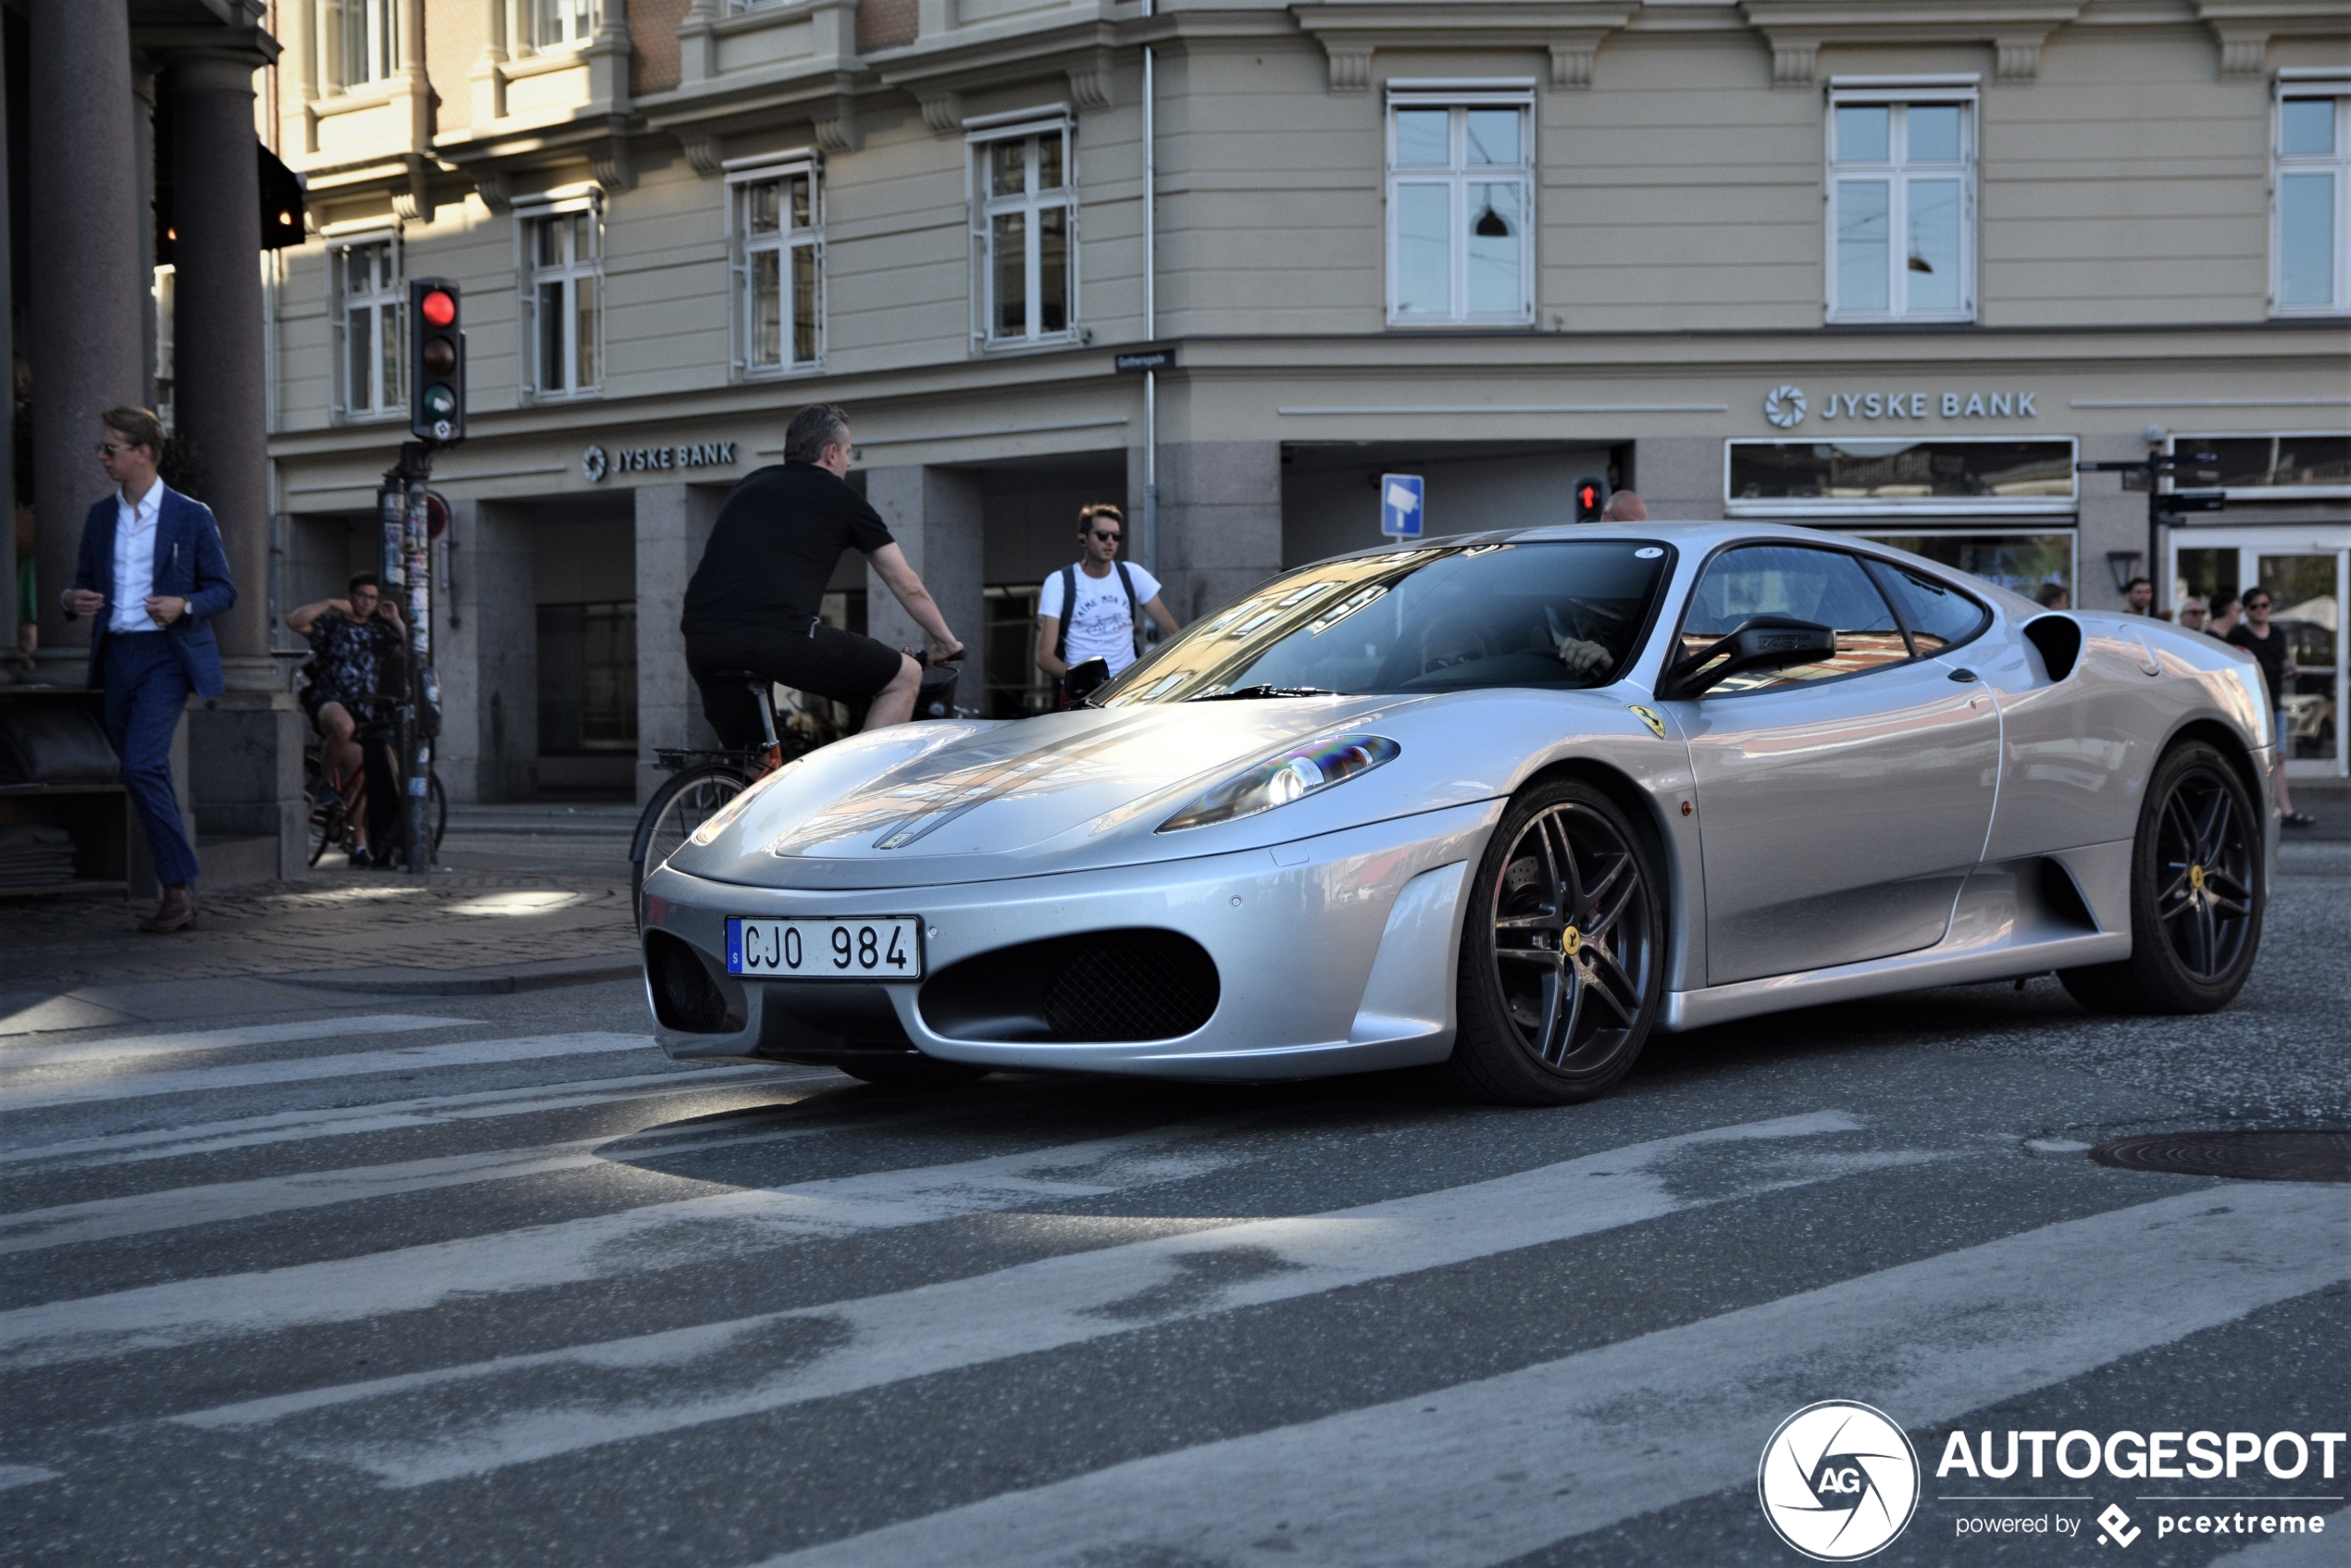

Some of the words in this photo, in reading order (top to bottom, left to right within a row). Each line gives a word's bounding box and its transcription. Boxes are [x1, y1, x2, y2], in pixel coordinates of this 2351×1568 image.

[1822, 392, 1928, 418] JYSKE
[1942, 392, 2036, 417] BANK
[612, 447, 672, 473] JYSKE
[678, 442, 736, 467] BANK
[1101, 594, 1119, 604] MON
[732, 952, 739, 964] S
[745, 926, 802, 969] CJO
[832, 926, 907, 969] 984
